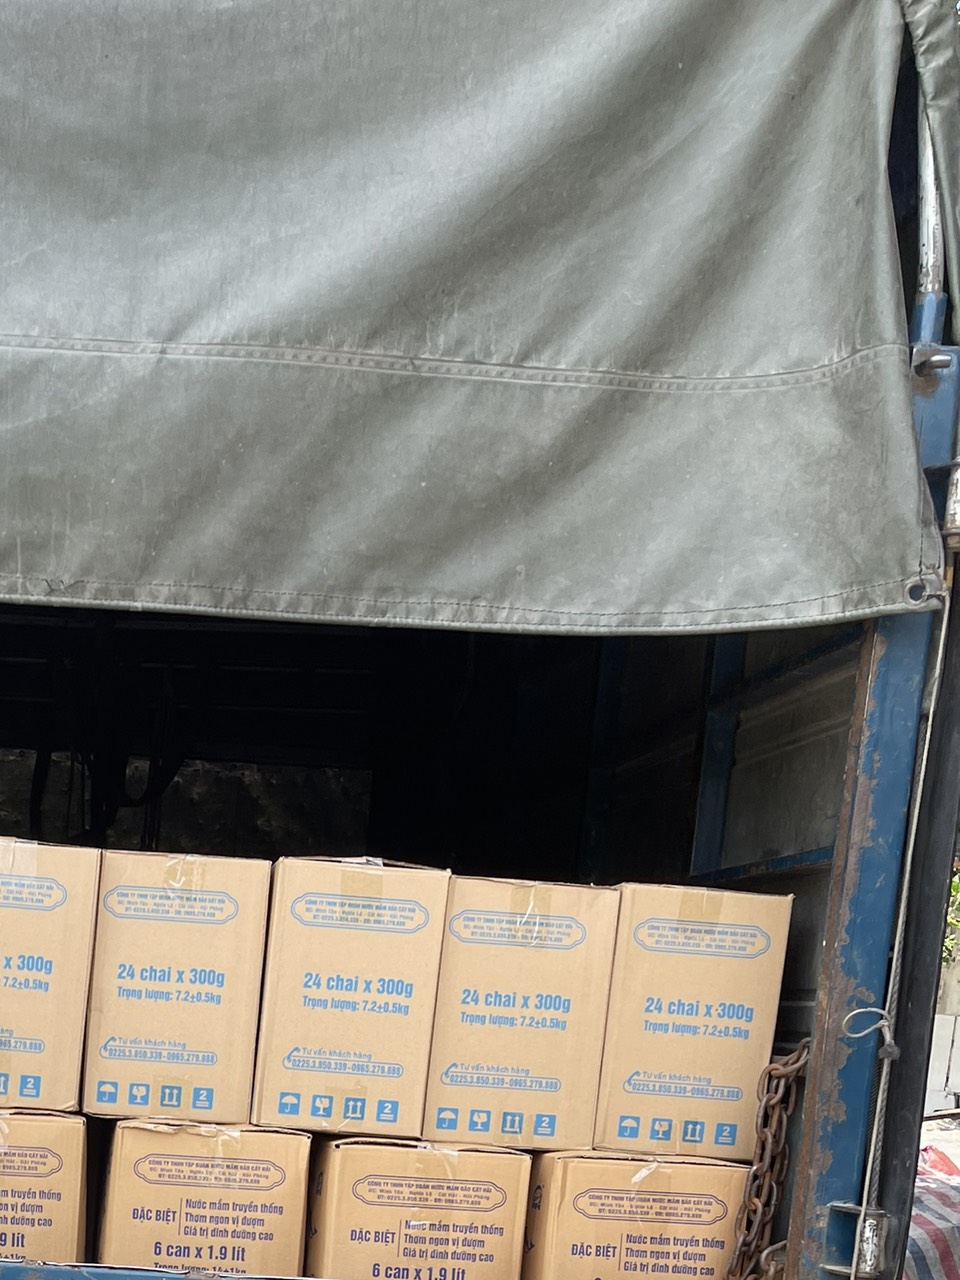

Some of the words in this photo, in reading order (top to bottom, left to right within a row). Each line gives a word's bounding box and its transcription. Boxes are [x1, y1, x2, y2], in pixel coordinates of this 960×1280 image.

[3, 956, 12, 969] x
[16, 954, 52, 975] 300g
[3, 976, 49, 992] 7.2±0.5kg
[116, 963, 135, 980] 24
[139, 965, 171, 982] chai
[175, 970, 185, 983] x
[188, 967, 224, 988] 300g
[303, 972, 321, 989] 24
[326, 974, 358, 992] chai
[362, 979, 372, 993] x
[376, 977, 413, 998] 300g
[116, 985, 142, 1000] Trọng
[144, 987, 173, 1002] lượng:
[175, 989, 221, 1005] 7.2±0.5kg
[460, 988, 479, 1005] 24
[484, 990, 516, 1008] chai
[520, 995, 530, 1008] x
[534, 993, 571, 1013] 300g
[302, 996, 328, 1009] Trọng
[330, 998, 359, 1012] lượng:
[362, 1000, 409, 1016] 7.2±0.5kg
[644, 996, 662, 1014] 24
[667, 998, 699, 1016] chai
[703, 1004, 713, 1017] x
[716, 1002, 754, 1023] 300g
[460, 1011, 486, 1025] Trọng
[488, 1013, 517, 1027] lượng:
[520, 1015, 567, 1031] 7.2±0.5kg
[644, 1019, 669, 1033] Trọng
[671, 1022, 700, 1036] lượng:
[702, 1024, 750, 1040] 7.2±0.5kg
[132, 1207, 152, 1223] ĐẶC
[154, 1209, 177, 1224] BIỆT
[11, 1232, 25, 1247] lít
[350, 1228, 371, 1244] ĐẶC
[373, 1230, 396, 1243] BIỆT
[153, 1241, 162, 1256] 6
[166, 1244, 190, 1258] can
[194, 1246, 202, 1258] x
[207, 1245, 227, 1260] 1.9
[231, 1246, 245, 1261] lít
[570, 1242, 592, 1258] ĐẶC
[594, 1244, 617, 1257] BIỆT
[372, 1262, 380, 1277] 6
[384, 1266, 409, 1279] can
[413, 1268, 422, 1280] x
